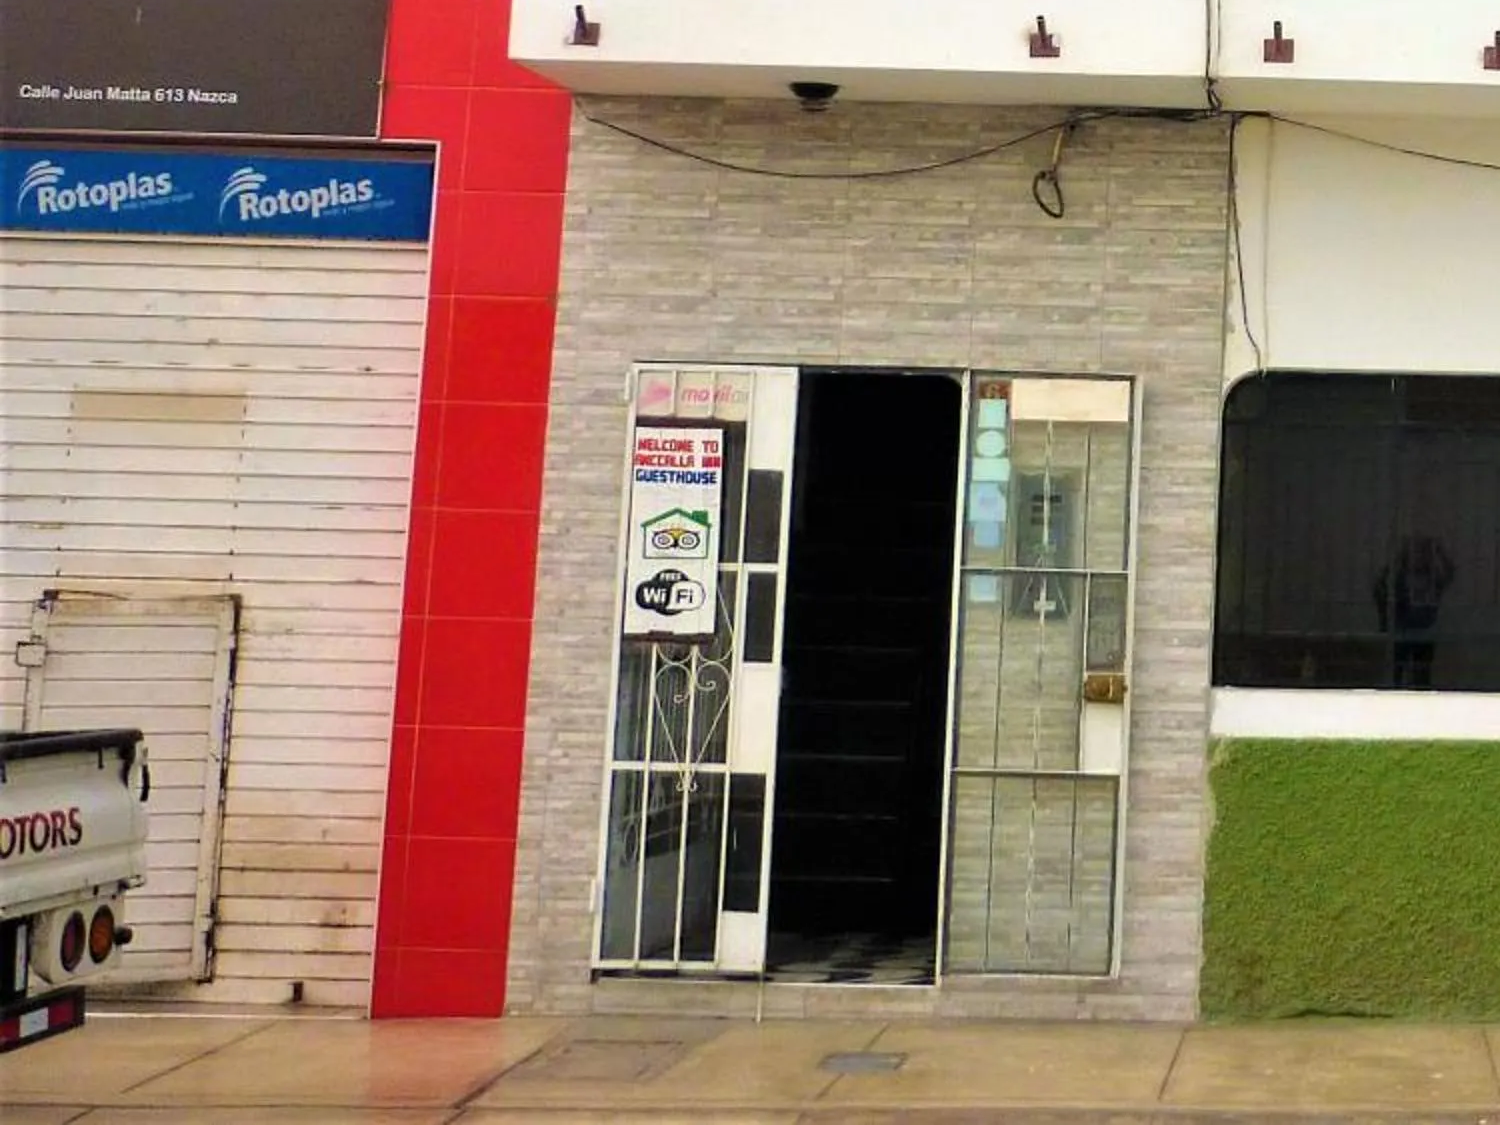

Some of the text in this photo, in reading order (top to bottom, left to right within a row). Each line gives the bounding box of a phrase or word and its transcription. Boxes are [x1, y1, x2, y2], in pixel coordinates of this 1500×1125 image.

[19, 84, 239, 105] Calle Juan Matta 613 Nazca
[37, 172, 173, 214] Rotoplas
[239, 178, 373, 222] Rotoplas
[638, 439, 719, 454] WELCOME TO
[635, 469, 718, 484] GUESTHOUSE
